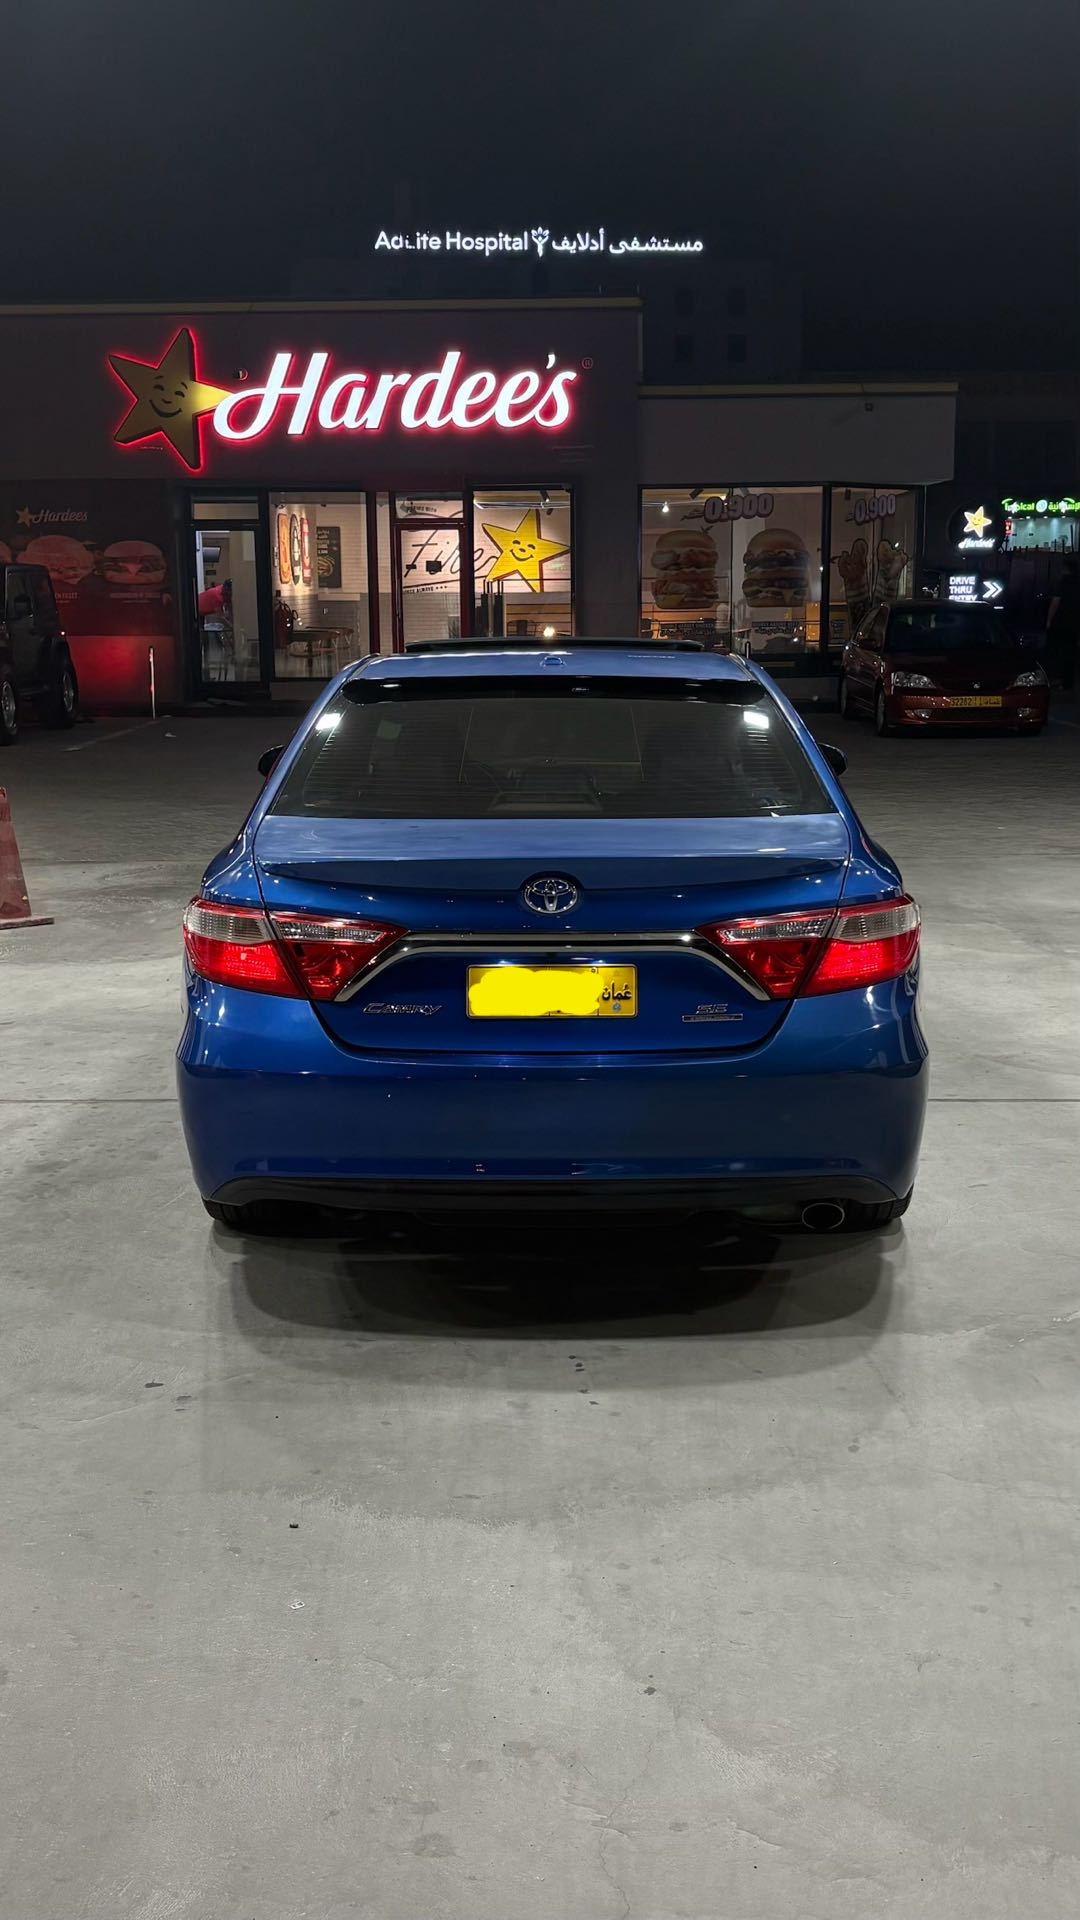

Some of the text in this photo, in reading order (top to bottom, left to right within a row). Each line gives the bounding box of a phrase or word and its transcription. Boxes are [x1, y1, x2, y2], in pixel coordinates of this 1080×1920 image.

[446, 231, 528, 256] Hospital
[551, 227, 704, 254] مستشفى أدلايف
[213, 350, 577, 441] Hardee's
[704, 493, 774, 523] 0.900
[855, 493, 897, 525] 0.900
[1001, 498, 1035, 513] Tpical
[948, 585, 973, 594] THRU
[949, 576, 976, 585] DRIVE
[362, 1002, 443, 1015] CAMRY
